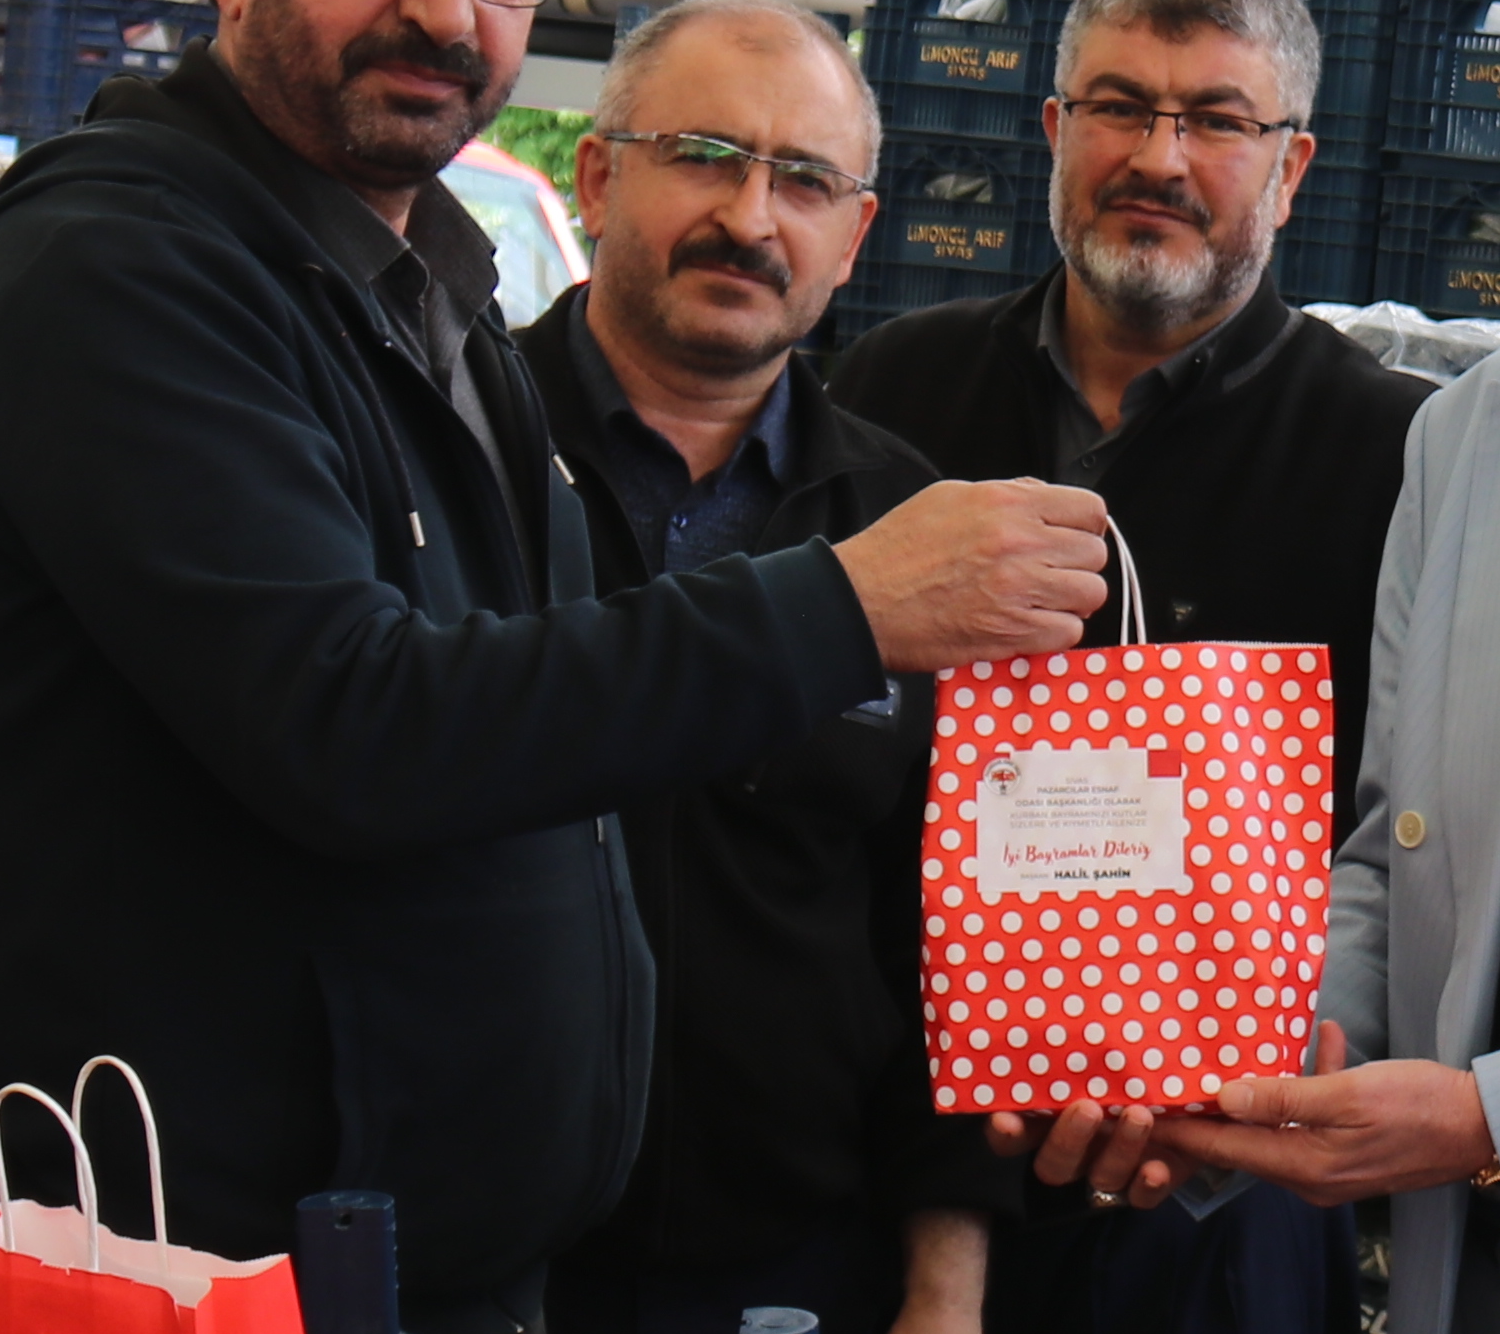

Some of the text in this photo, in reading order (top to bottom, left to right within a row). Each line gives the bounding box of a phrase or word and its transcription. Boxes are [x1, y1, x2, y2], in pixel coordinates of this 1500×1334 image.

[1103, 797, 1142, 805] OLARAK
[1025, 842, 1097, 865] Bayramlar
[1103, 839, 1151, 861] Dileriz
[1092, 868, 1131, 881] ŞAHİN
